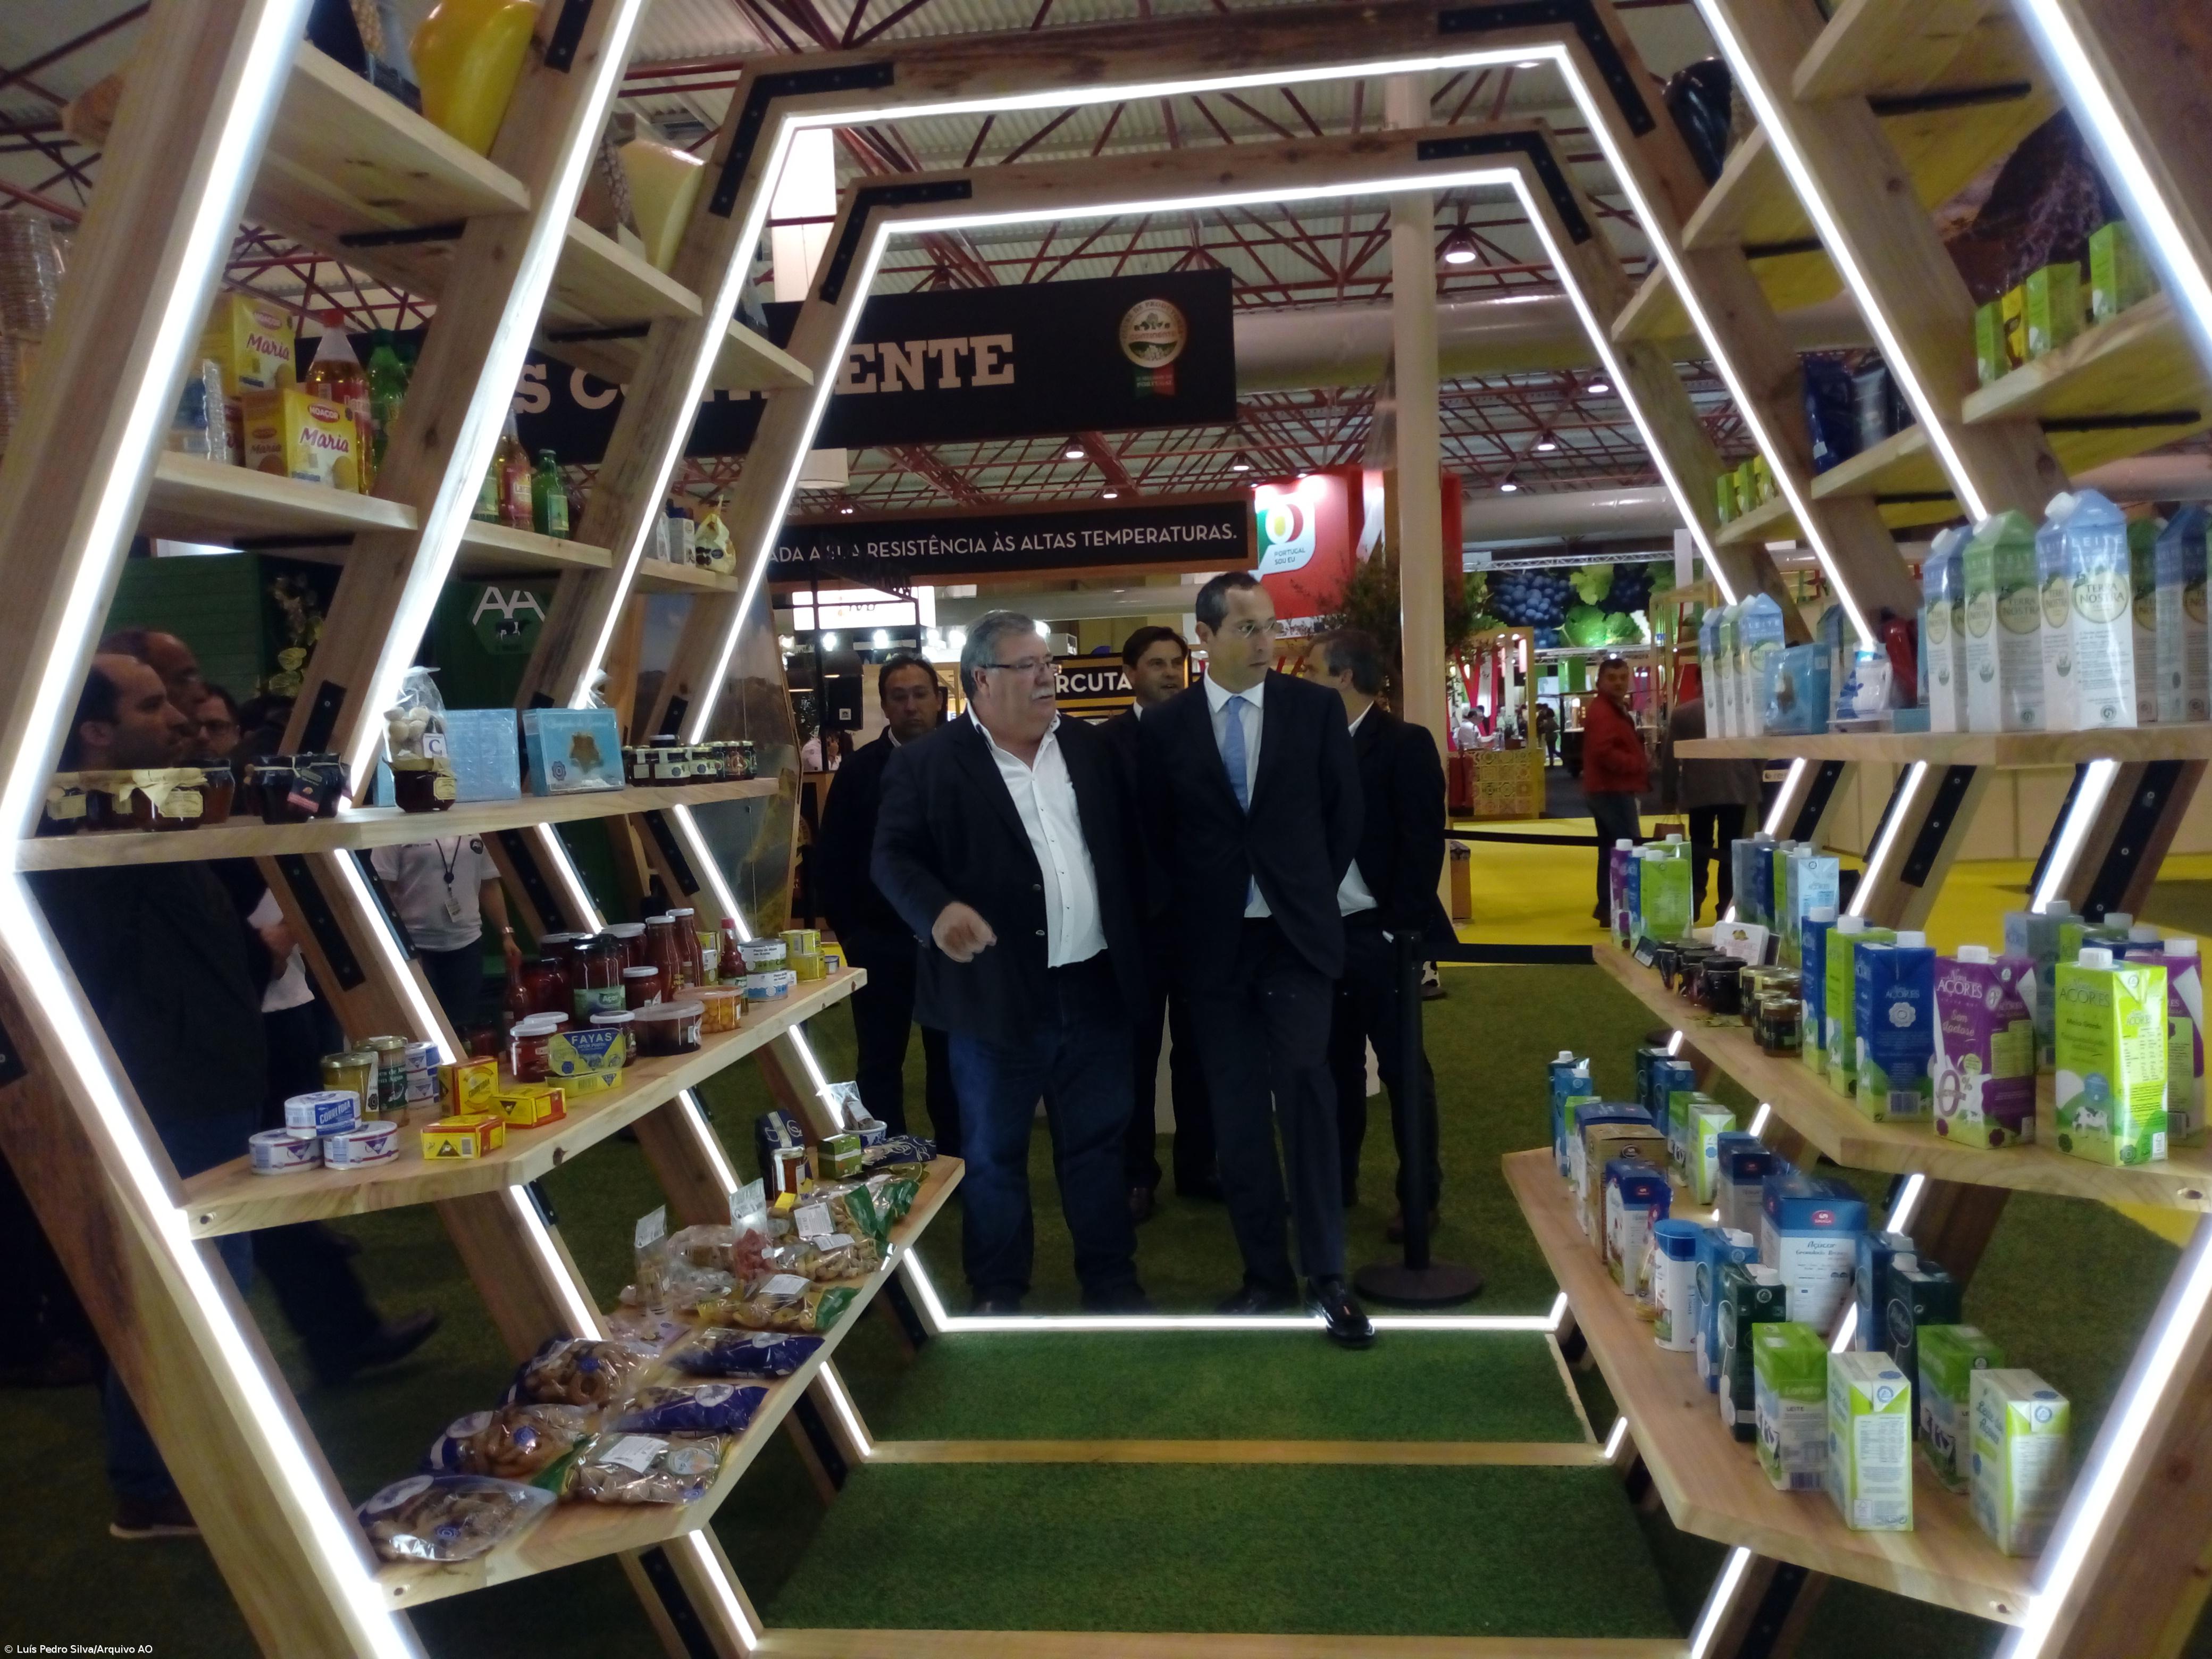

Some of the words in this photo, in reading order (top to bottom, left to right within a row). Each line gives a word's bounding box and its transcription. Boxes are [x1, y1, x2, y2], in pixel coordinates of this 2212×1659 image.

[246, 333, 289, 361] Maria
[300, 427, 349, 453] Maria
[867, 534, 987, 558] RESISTÊNCIA
[992, 532, 1016, 552] ÀS
[1020, 532, 1077, 551] ALTAS
[1081, 523, 1238, 547] TEMPERATURAS.
[1937, 979, 1983, 999] AÇORES
[2059, 987, 2110, 1008] AÇORES
[571, 1032, 613, 1045] FAYAS
